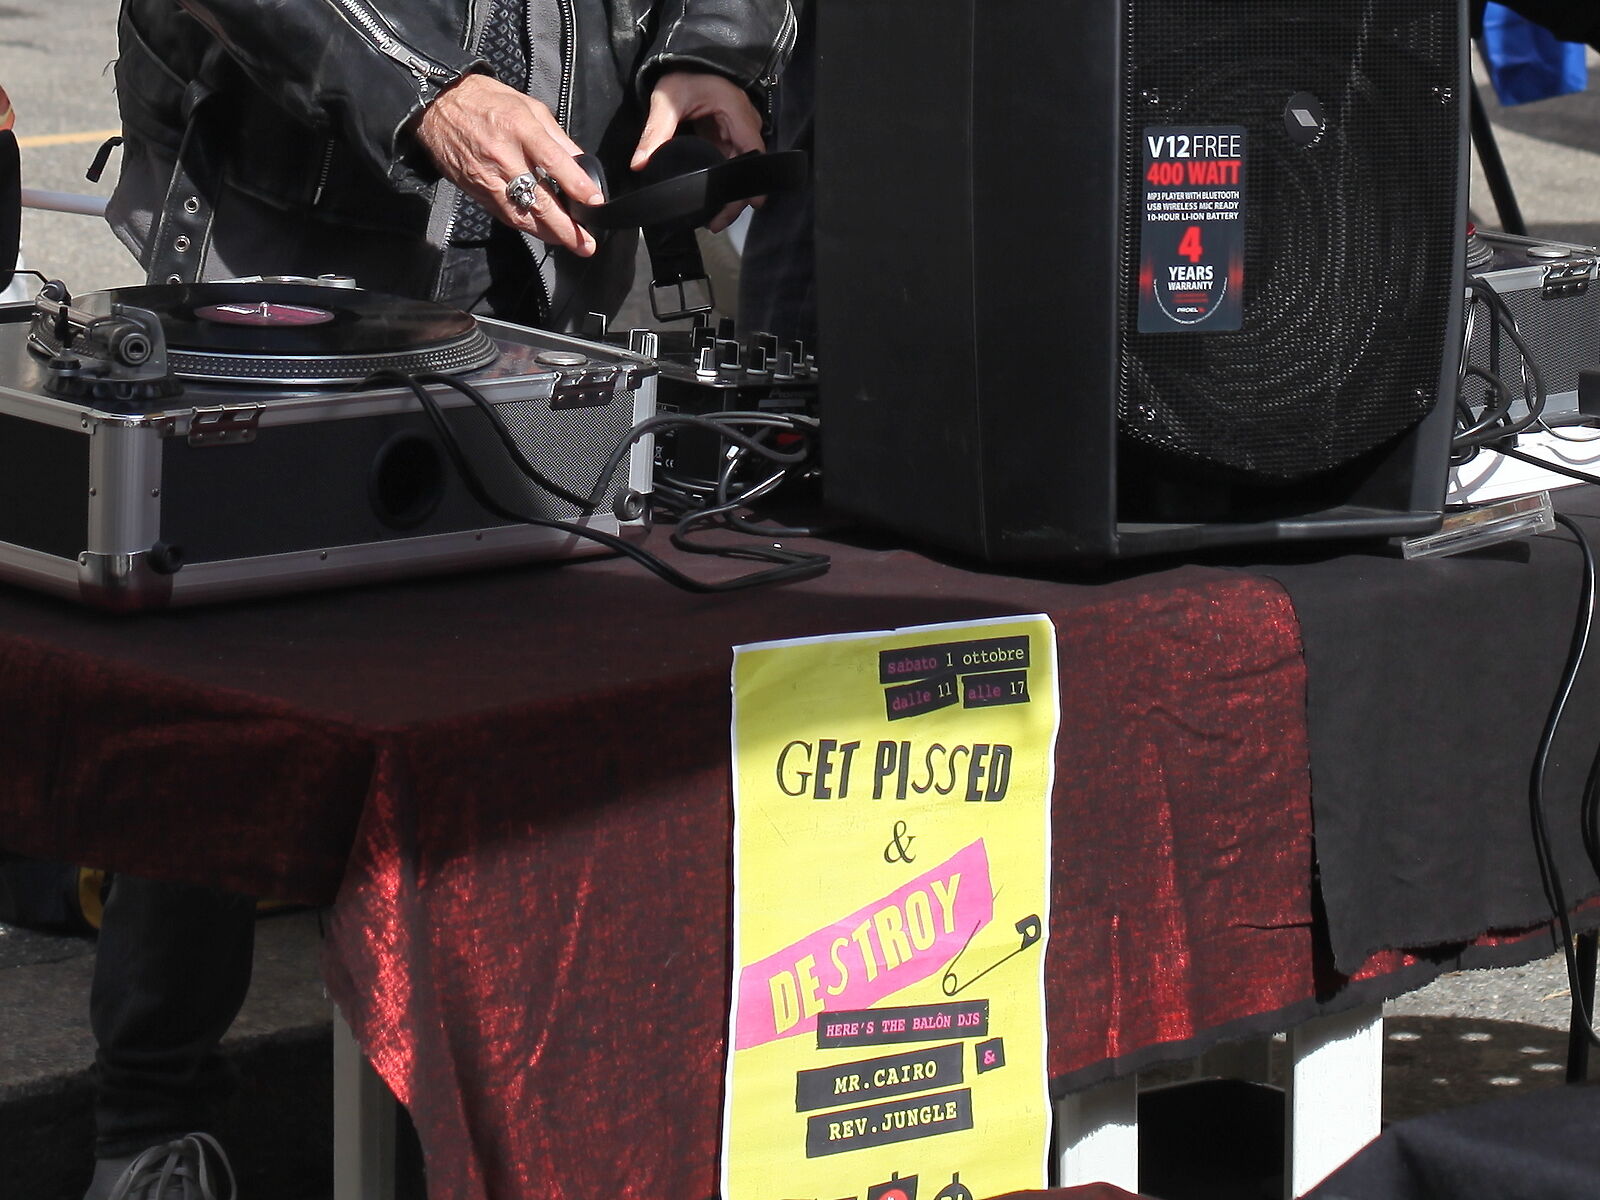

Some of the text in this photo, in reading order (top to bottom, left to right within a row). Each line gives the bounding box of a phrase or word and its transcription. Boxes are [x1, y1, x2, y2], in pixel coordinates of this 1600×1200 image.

[1146, 160, 1242, 186] 400 WATT
[1147, 191, 1240, 201] MP3 PLAYER WITH BLUETOOTH
[1147, 202, 1240, 211] USB WIRELESS MIC READY
[1147, 212, 1240, 221] 10-HOUR LI-ION BATTERY
[1178, 226, 1203, 263] 4
[1168, 266, 1214, 281] YEARS
[1168, 281, 1214, 291] WARRANTY
[888, 648, 1024, 675] sabato 1 ottobre
[892, 681, 1025, 711] dalle 11 alle 17
[776, 738, 1012, 803] GET PISSED
[883, 820, 917, 864] &
[768, 873, 962, 1035] DESTROY
[826, 1012, 980, 1037] HERE'S THE BALÔN DJS
[834, 1050, 996, 1095] MR.CAIRO &
[828, 1101, 958, 1142] REV.JUNGLE
